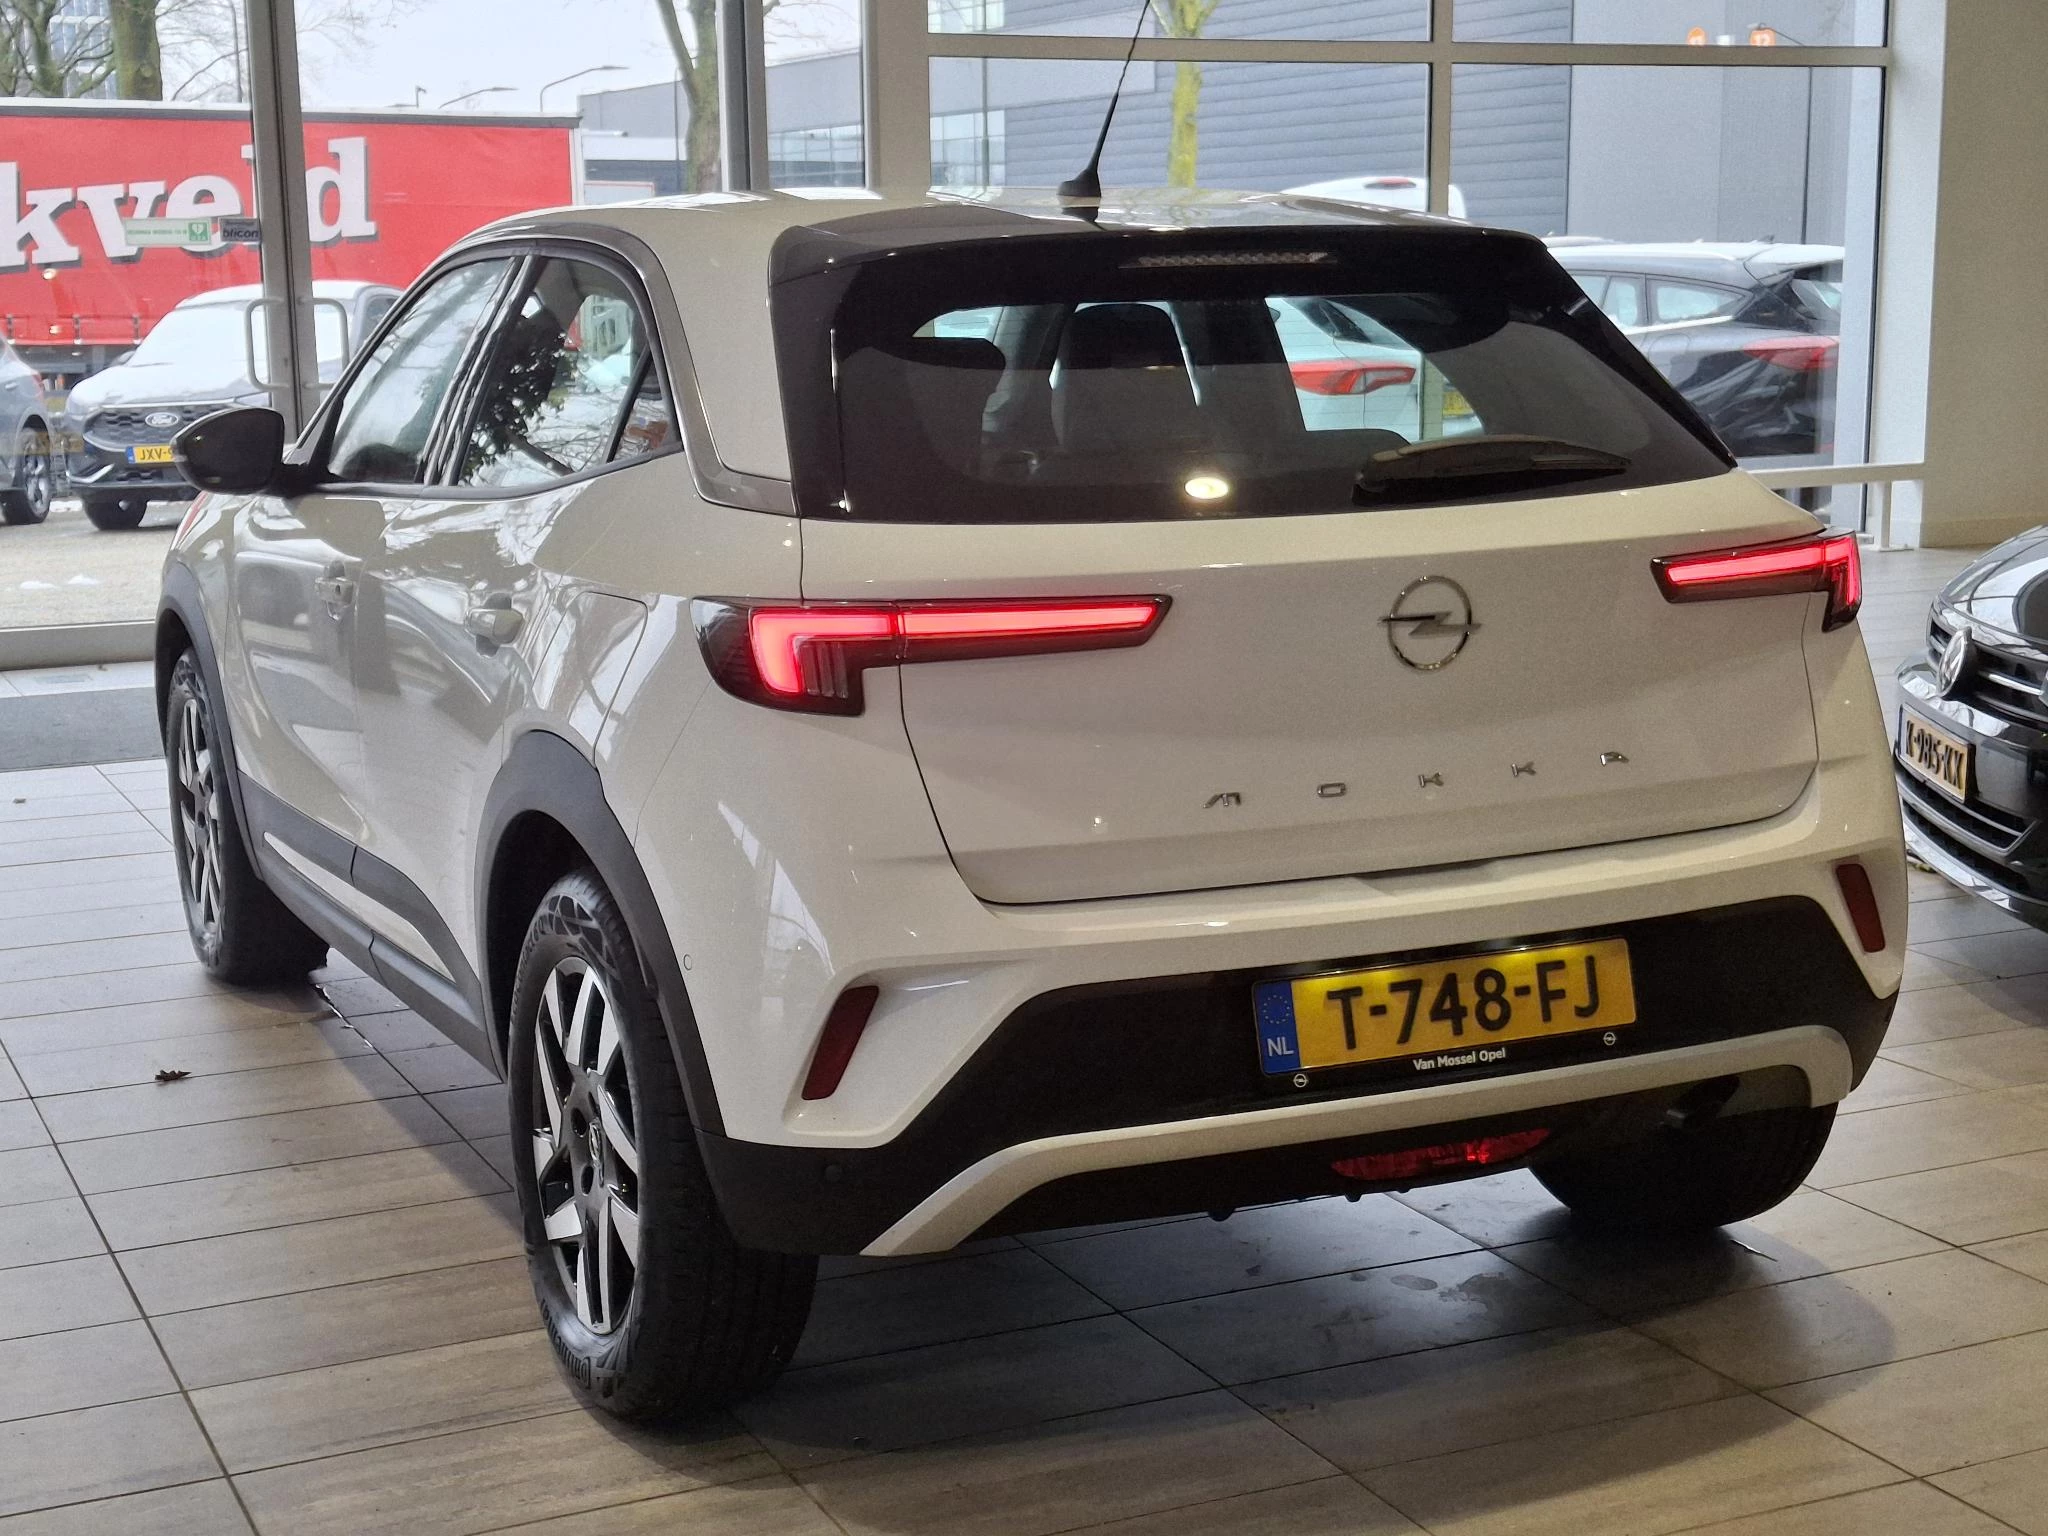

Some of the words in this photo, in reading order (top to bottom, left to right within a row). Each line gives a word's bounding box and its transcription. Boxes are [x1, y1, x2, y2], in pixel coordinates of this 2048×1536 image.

[1326, 955, 1601, 1051] T-748-FJ
[1266, 1036, 1294, 1057] NL
[1413, 1059, 1435, 1071] Van
[1437, 1051, 1476, 1068] Mossel
[1479, 1047, 1507, 1063] Opel
